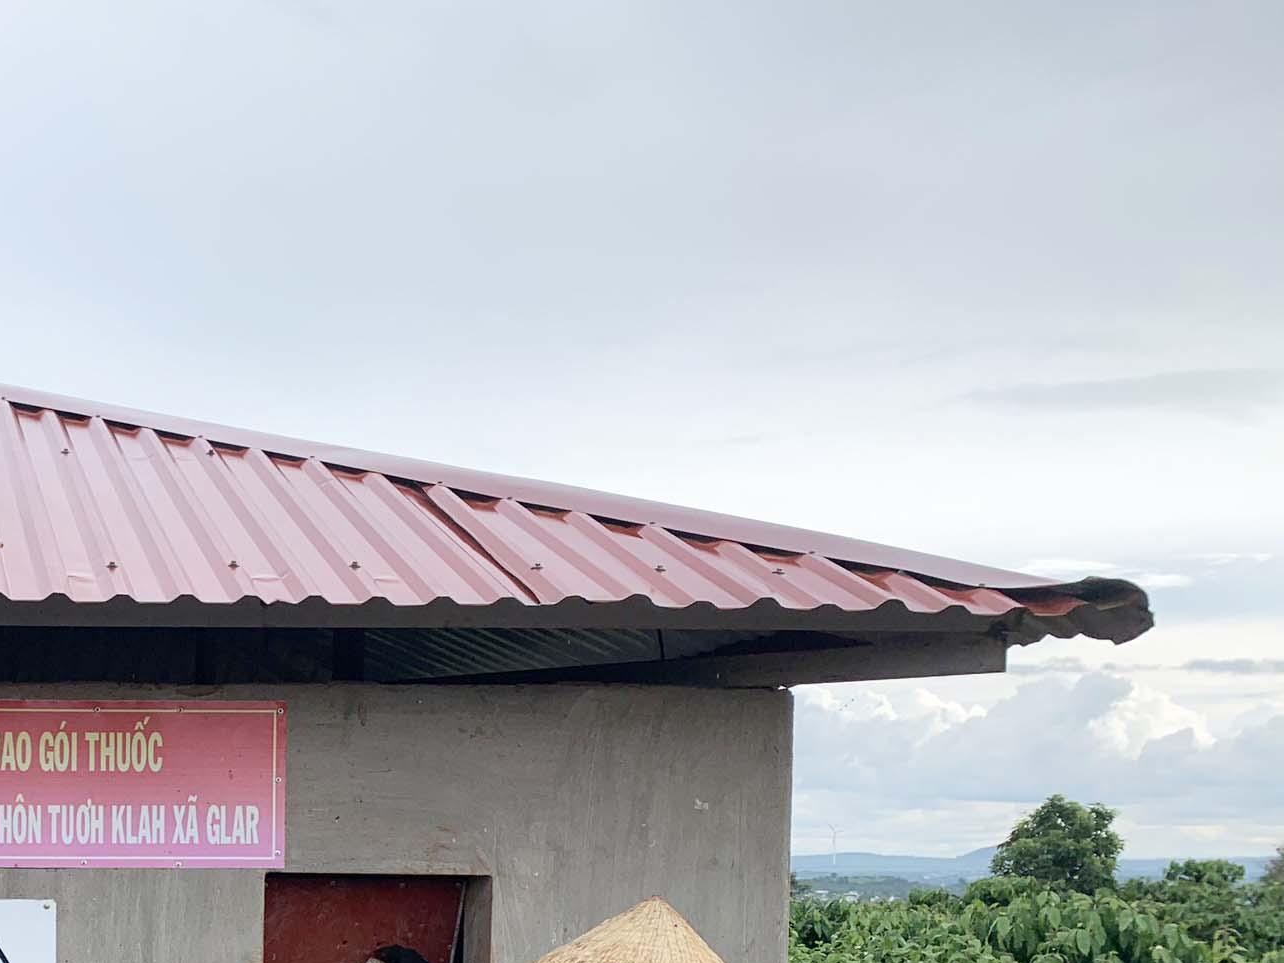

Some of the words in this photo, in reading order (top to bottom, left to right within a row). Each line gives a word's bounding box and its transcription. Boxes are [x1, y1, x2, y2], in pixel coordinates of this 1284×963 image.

[39, 721, 77, 772] GÓI
[84, 716, 163, 773] THUỐC
[112, 804, 165, 845] KLAH
[172, 795, 199, 845] XÃ
[206, 804, 259, 845] GLAR
